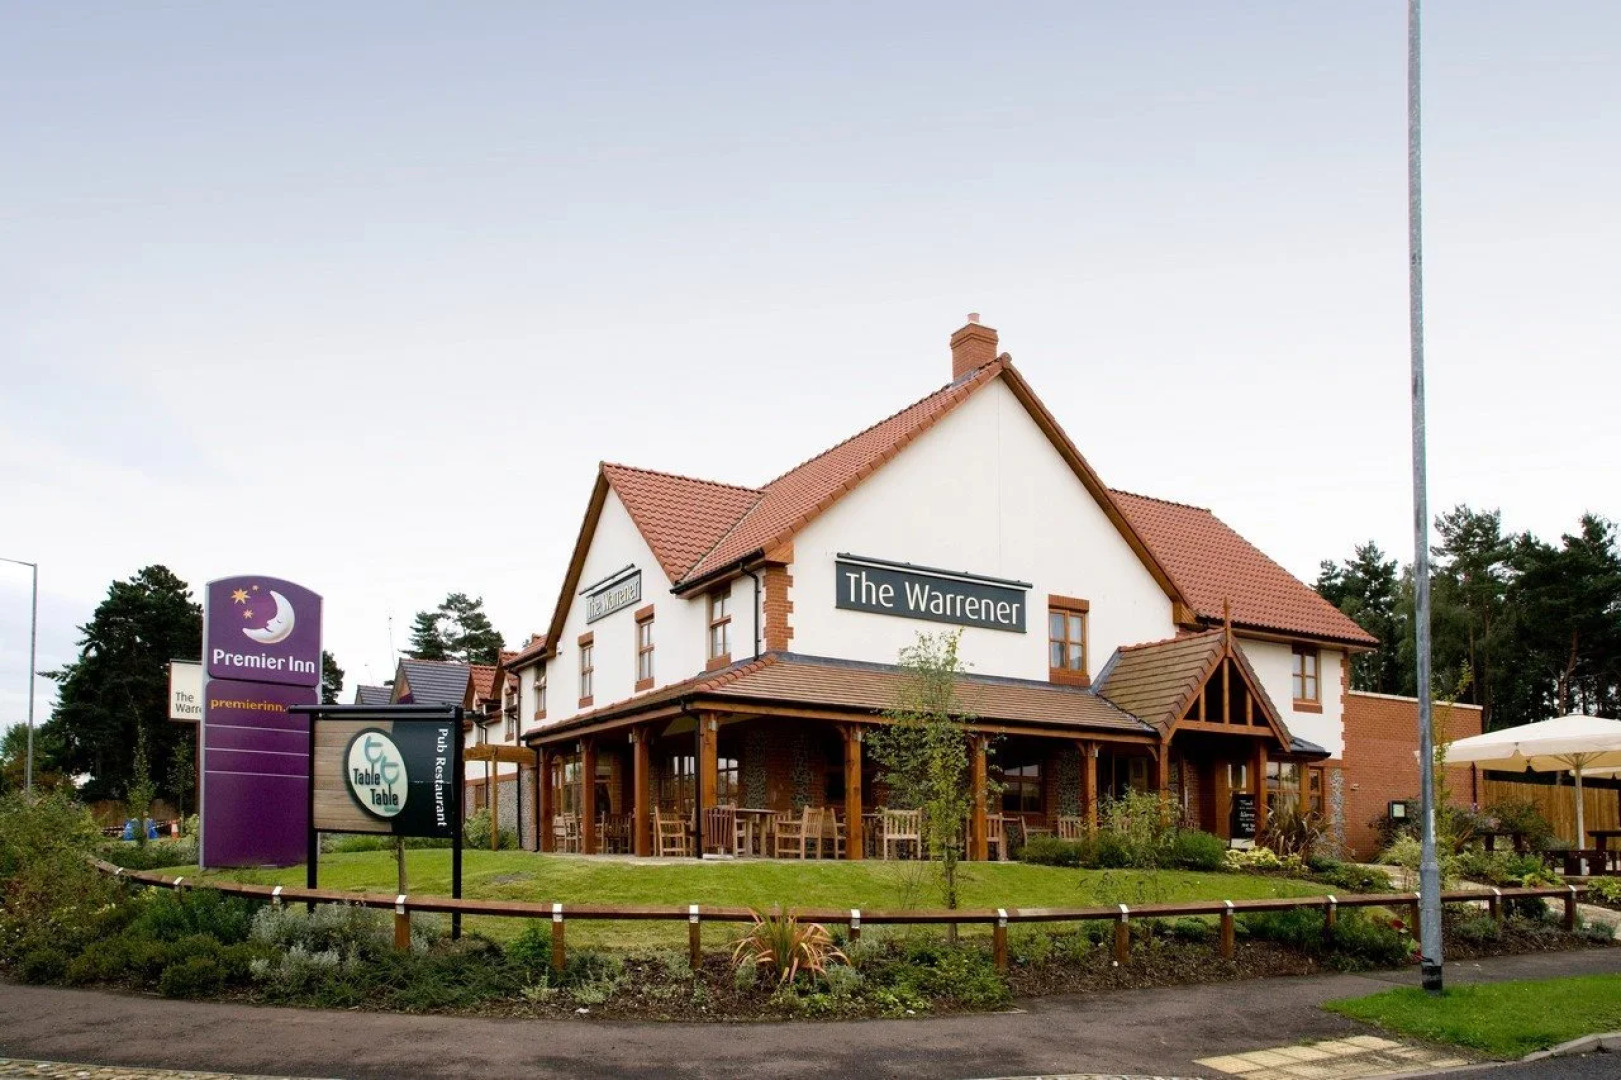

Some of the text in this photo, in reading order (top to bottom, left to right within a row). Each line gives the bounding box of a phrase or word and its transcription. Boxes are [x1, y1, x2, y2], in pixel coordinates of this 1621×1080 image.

[845, 571, 1020, 625] The Warrener
[213, 648, 315, 674] Premier Inn
[175, 691, 194, 703] The
[353, 768, 381, 786] Table
[434, 728, 449, 827] Pub Restaurant
[370, 788, 400, 807] Table
